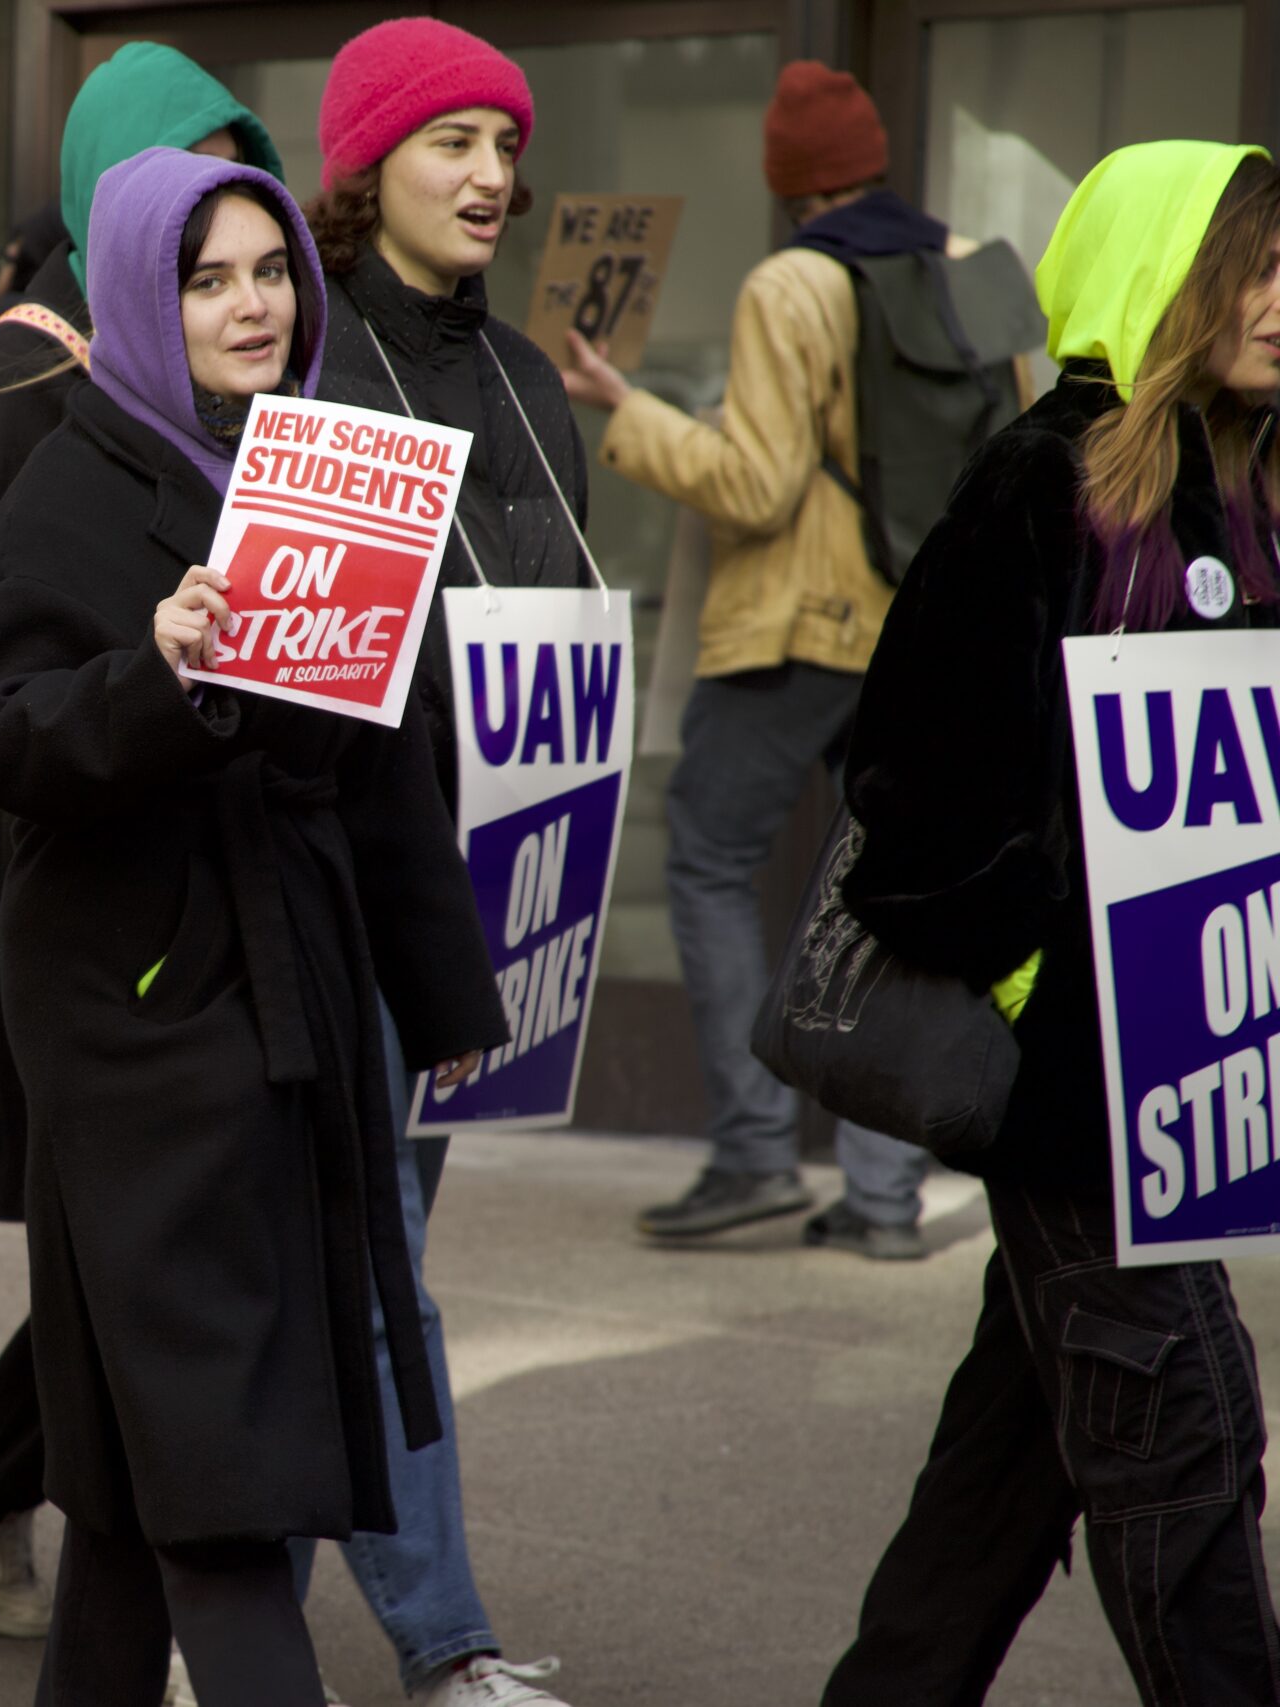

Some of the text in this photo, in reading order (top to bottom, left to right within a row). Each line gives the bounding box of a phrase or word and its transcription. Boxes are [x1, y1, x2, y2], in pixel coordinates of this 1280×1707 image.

[560, 206, 653, 245] WE ARE
[253, 410, 455, 476] NEW SCHOOL
[241, 446, 447, 521] STUDENTS
[260, 543, 347, 601] ON
[213, 606, 405, 663] STRIKE
[275, 662, 386, 683] IN SOLIDARITY
[467, 642, 622, 767] UAW
[504, 812, 571, 950] ON
[1201, 880, 1280, 1037] ON
